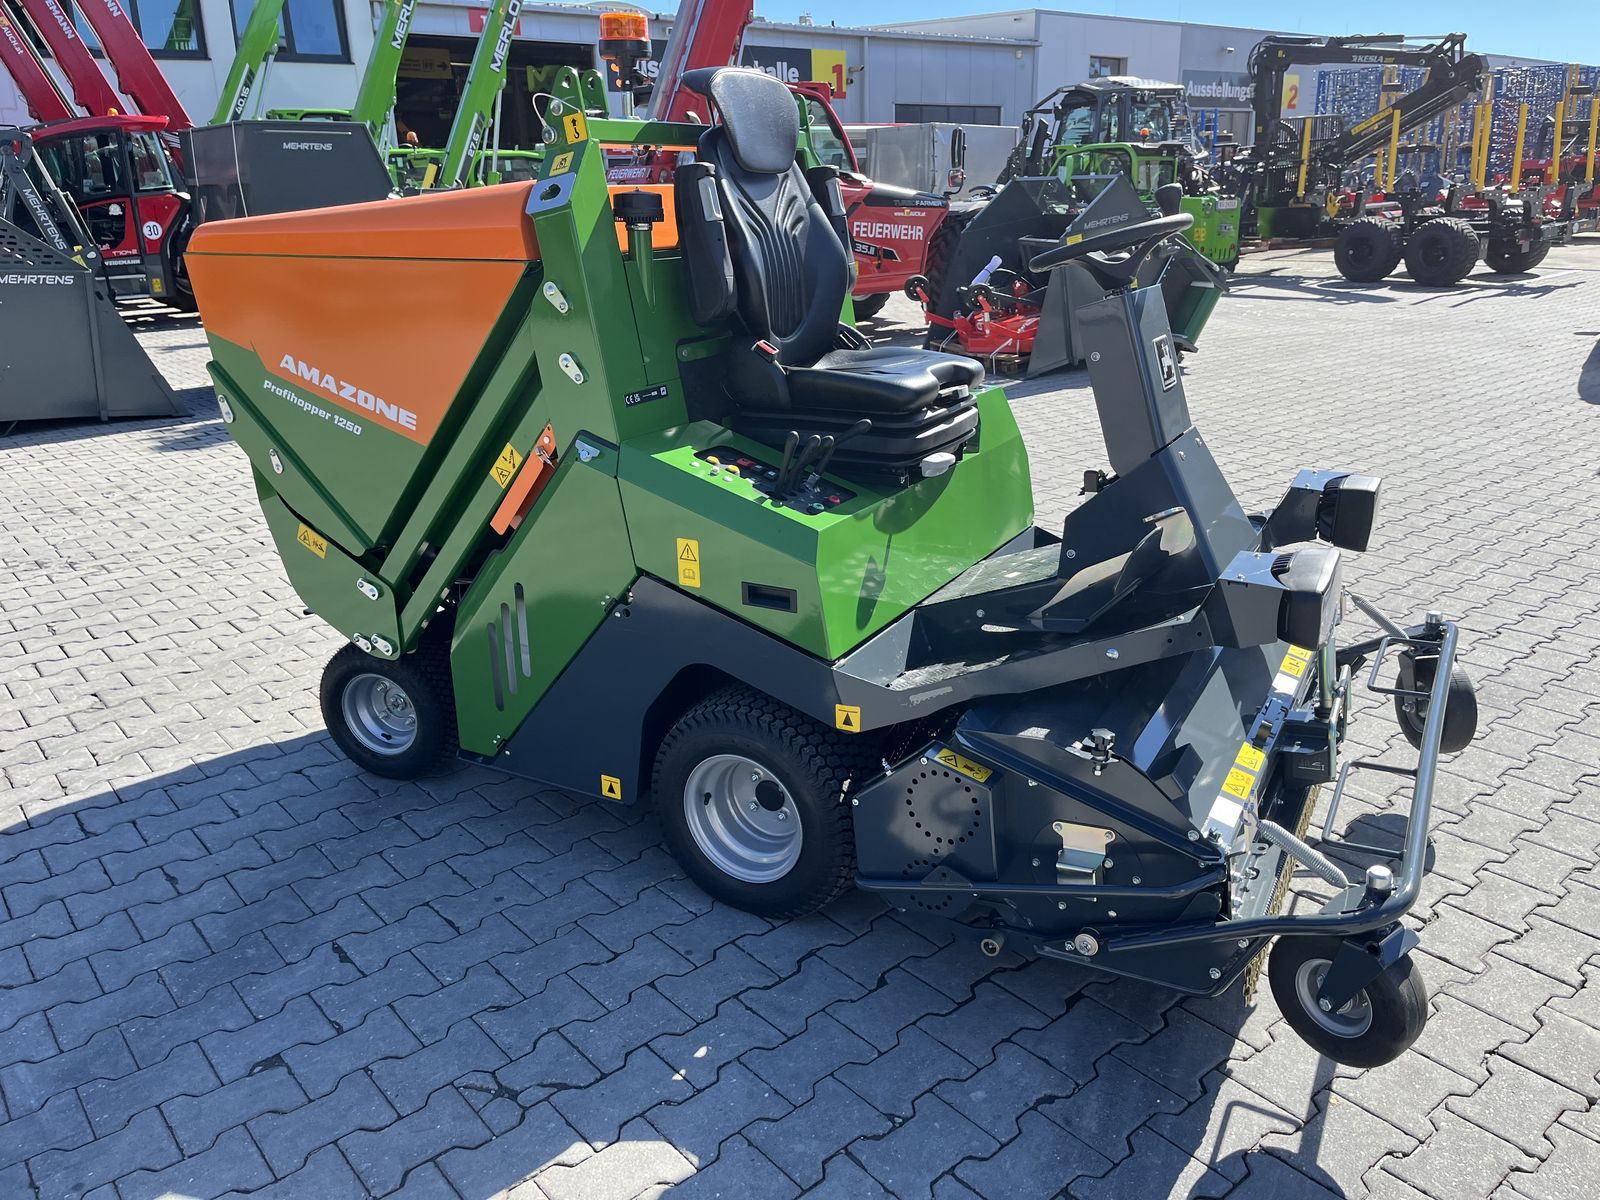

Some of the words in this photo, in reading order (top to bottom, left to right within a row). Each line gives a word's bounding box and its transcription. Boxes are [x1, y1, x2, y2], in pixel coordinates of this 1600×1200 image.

[490, 0, 521, 73] MERLO
[832, 63, 847, 99] 1
[1286, 84, 1298, 110] 2
[282, 142, 333, 151] MEHRTENS
[22, 188, 67, 250] MEHRTENS
[145, 224, 159, 237] 30
[853, 221, 924, 241] FEUERWEHR
[1084, 213, 1130, 231] MEHRTENS
[0, 274, 75, 285] MEHRTENS
[279, 353, 417, 431] AMAZONE
[263, 379, 332, 421] Profihopper
[333, 414, 363, 436] 1250
